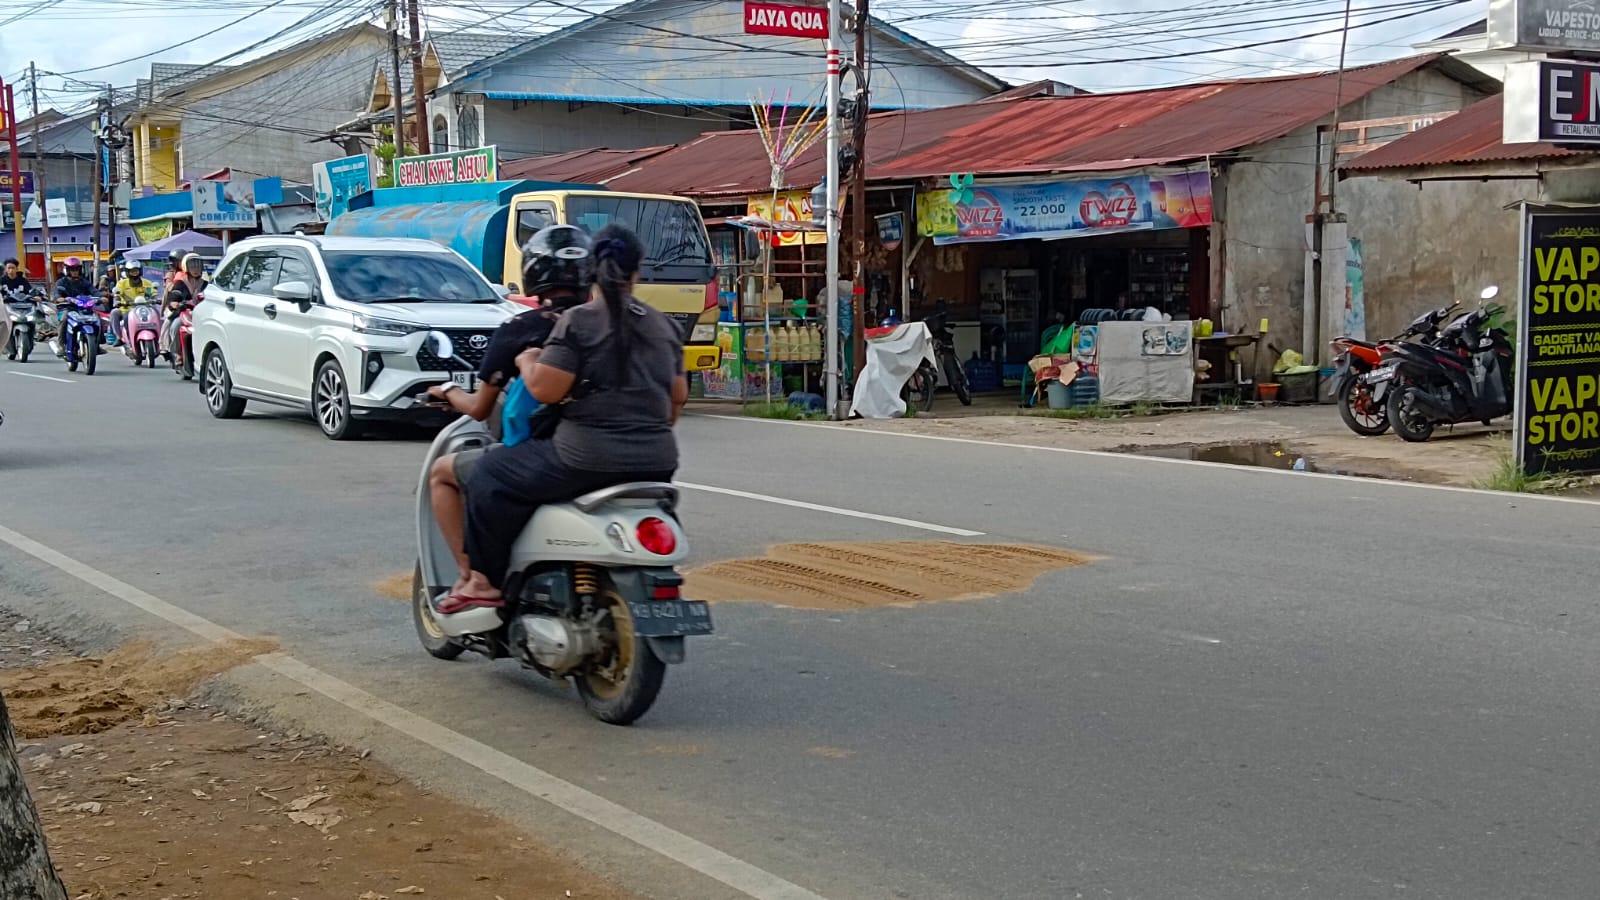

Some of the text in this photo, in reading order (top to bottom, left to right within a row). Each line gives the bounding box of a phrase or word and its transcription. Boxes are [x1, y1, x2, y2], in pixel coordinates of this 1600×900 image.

[748, 8, 823, 30] JAYA QUA
[1538, 27, 1560, 37] LIQUID
[1564, 29, 1588, 39] DEVICE
[1562, 124, 1582, 135] RETAIL
[399, 153, 488, 186] CHAI KWE AHUI
[1083, 196, 1137, 215] TWIZZ
[199, 212, 254, 221] COMPUTER
[1534, 246, 1600, 282] VAP
[1534, 333, 1583, 346] GADGET
[1530, 375, 1600, 412] VAP
[1528, 411, 1599, 445] STOR
